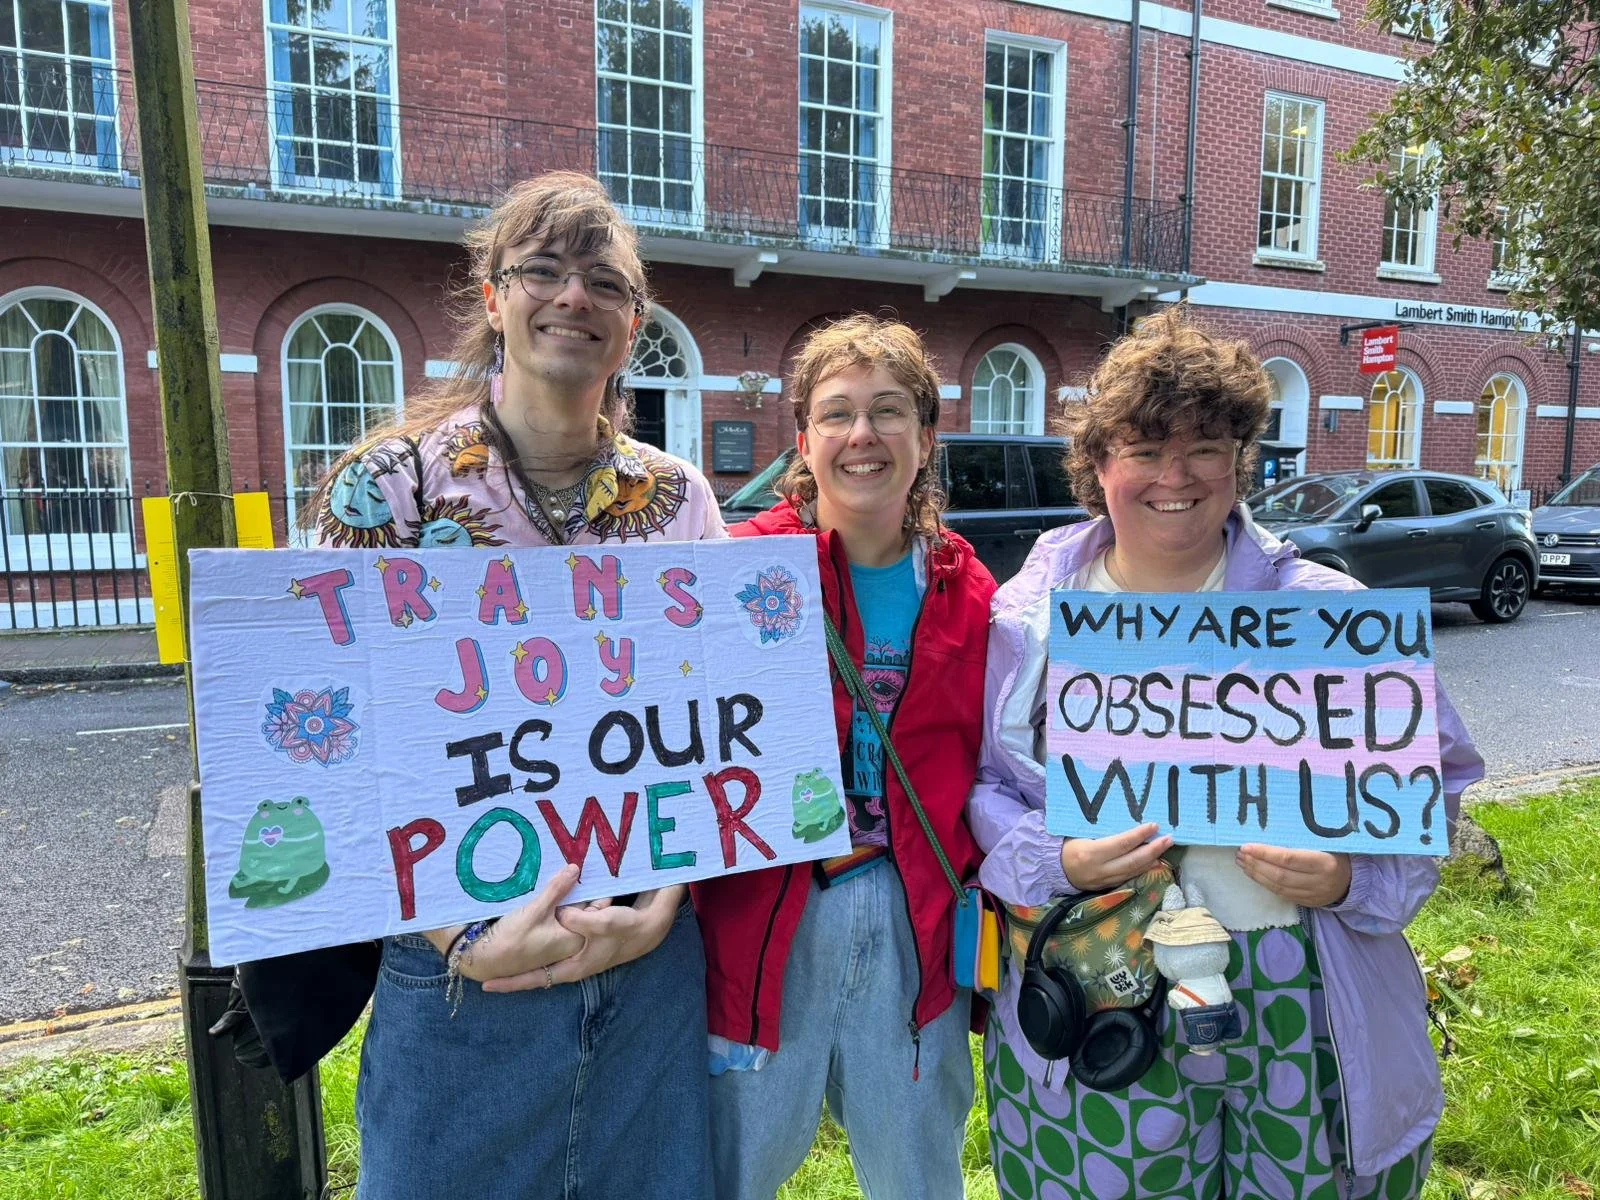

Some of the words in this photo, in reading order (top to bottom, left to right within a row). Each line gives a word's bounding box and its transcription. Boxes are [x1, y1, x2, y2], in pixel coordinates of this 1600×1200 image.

[1364, 335, 1394, 346] Lambert
[1395, 302, 1443, 320] Lambert
[1446, 306, 1478, 323] Smith
[1480, 309, 1529, 329] Hamptn
[1362, 354, 1395, 365] Hampton
[1363, 345, 1385, 356] Smith
[1549, 554, 1567, 564] PPZ
[294, 554, 704, 646] TRANS
[1059, 601, 1181, 641] WHY
[1188, 604, 1302, 650] ARE
[1317, 606, 1431, 659] YOU
[434, 632, 637, 713] JOY
[1058, 670, 1424, 753] OBSESSED
[445, 718, 561, 808] IS
[588, 693, 764, 776] OUR
[1061, 753, 1268, 831] WITH
[1299, 758, 1442, 847] US?
[385, 766, 778, 921] POWER
